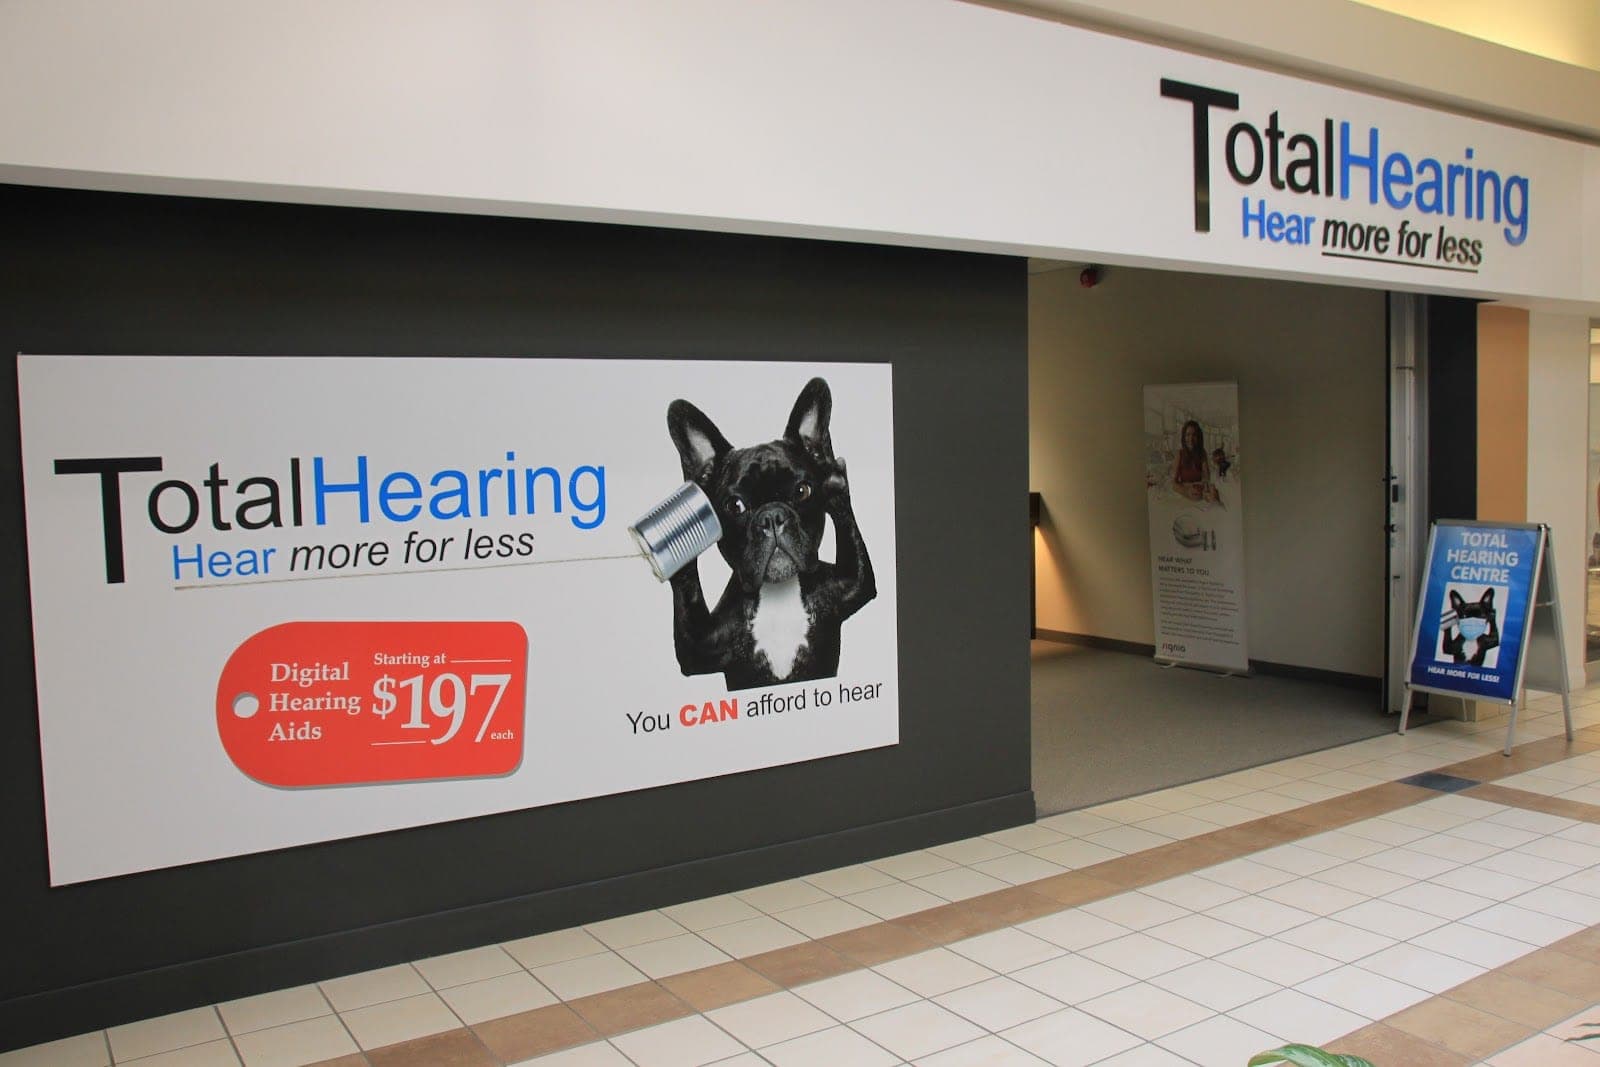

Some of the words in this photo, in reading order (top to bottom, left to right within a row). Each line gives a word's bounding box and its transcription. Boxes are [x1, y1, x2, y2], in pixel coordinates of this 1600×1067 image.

[1160, 78, 1529, 246] TotalHearing
[1242, 196, 1316, 245] Hear
[1322, 218, 1390, 254] more
[1397, 220, 1432, 259] for
[1436, 226, 1483, 266] less
[54, 451, 606, 585] TotalHearing
[1461, 532, 1509, 548] TOTAL
[172, 543, 276, 580] Hear
[289, 534, 390, 572] more
[402, 529, 454, 565] for
[464, 528, 535, 560] less
[1447, 549, 1519, 567] HEARING
[1158, 565, 1185, 574] MATTERS
[1186, 567, 1195, 575] TO
[1196, 568, 1210, 576] YOU
[1451, 565, 1510, 583] CENTRE
[373, 652, 430, 668] Starting
[433, 653, 446, 665] at
[270, 661, 349, 687] Digital
[1427, 666, 1446, 676] HEAR
[1447, 669, 1467, 679] MORE
[1467, 671, 1481, 681] FOR
[1481, 673, 1500, 683] LESS!
[269, 692, 362, 715] Hearing
[372, 672, 512, 746] $197
[626, 711, 670, 734] You
[679, 698, 738, 727] CAN
[746, 692, 806, 718] afford
[814, 689, 832, 708] to
[839, 681, 883, 705] hear
[268, 721, 322, 742] Aids
[490, 730, 514, 741] each
